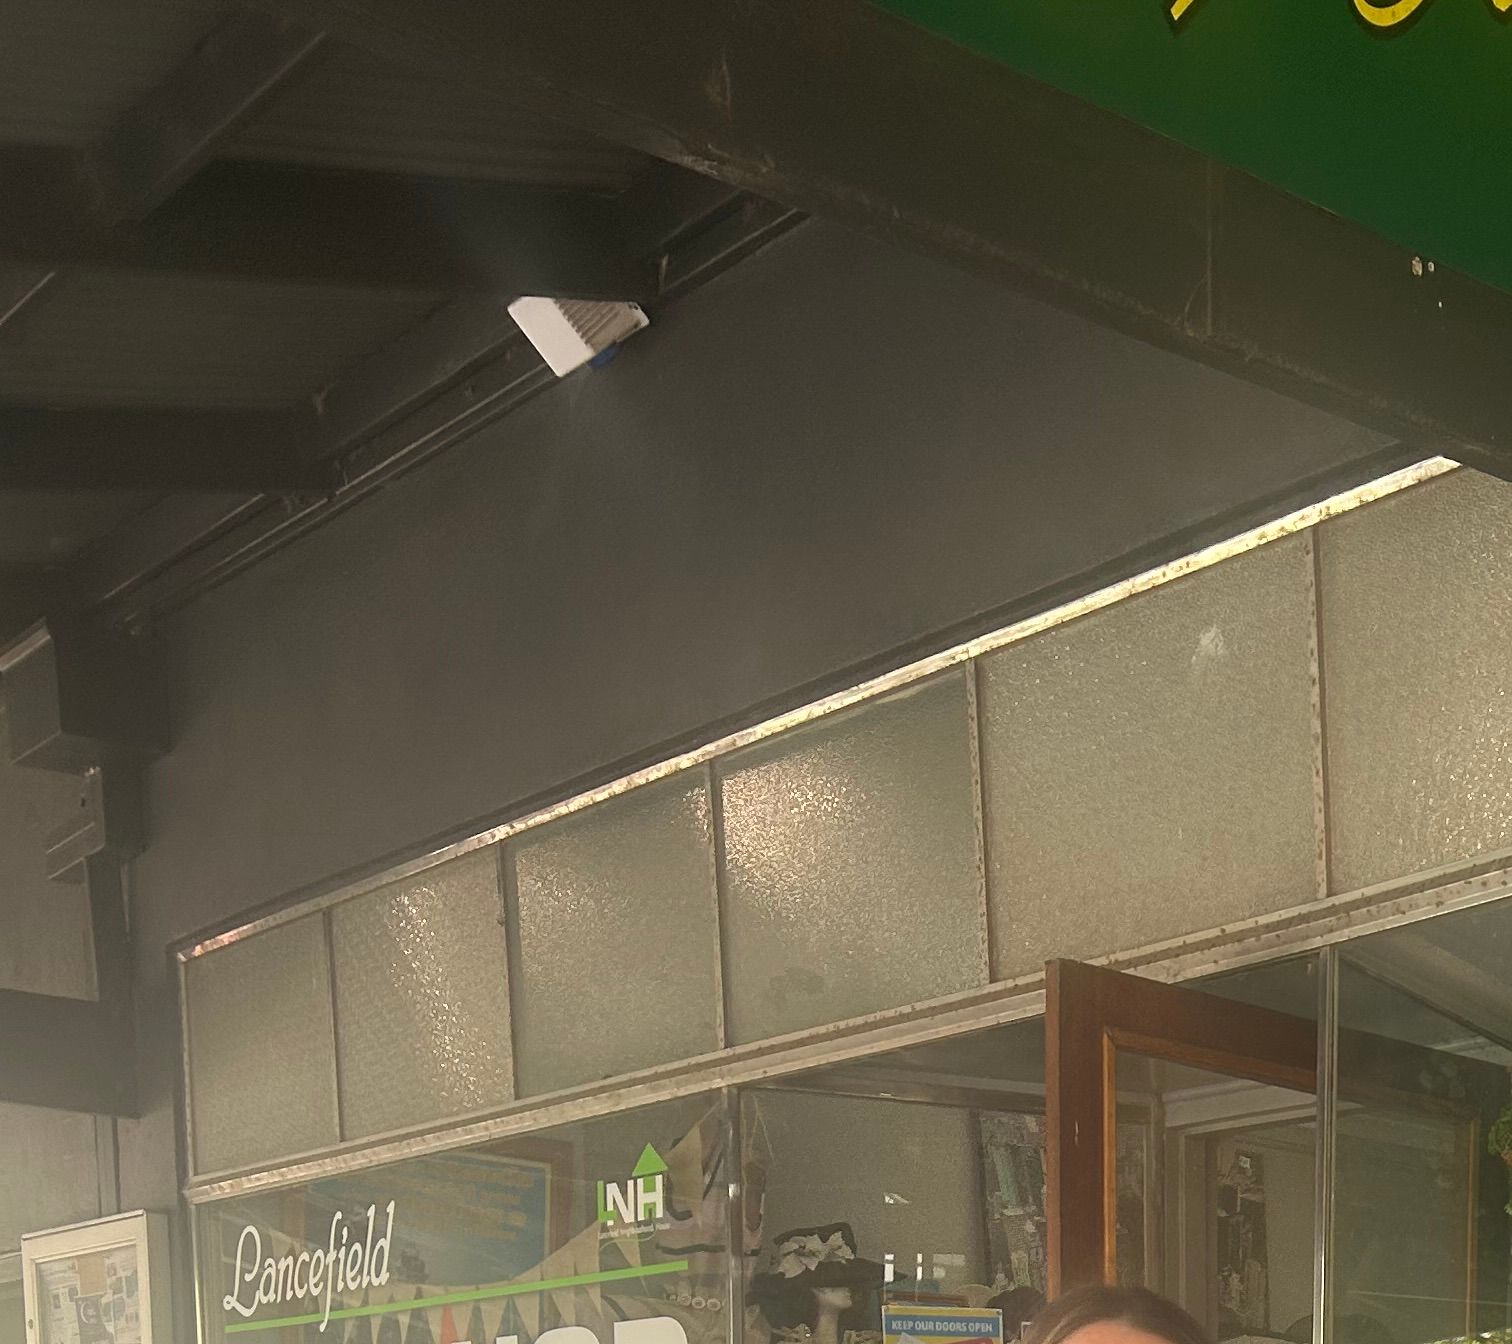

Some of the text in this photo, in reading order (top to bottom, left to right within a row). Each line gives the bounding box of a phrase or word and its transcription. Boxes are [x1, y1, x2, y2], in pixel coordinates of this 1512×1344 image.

[223, 1200, 395, 1332] Lancefield
[892, 1320, 993, 1332] KEEP OUR DOORS OPEN
